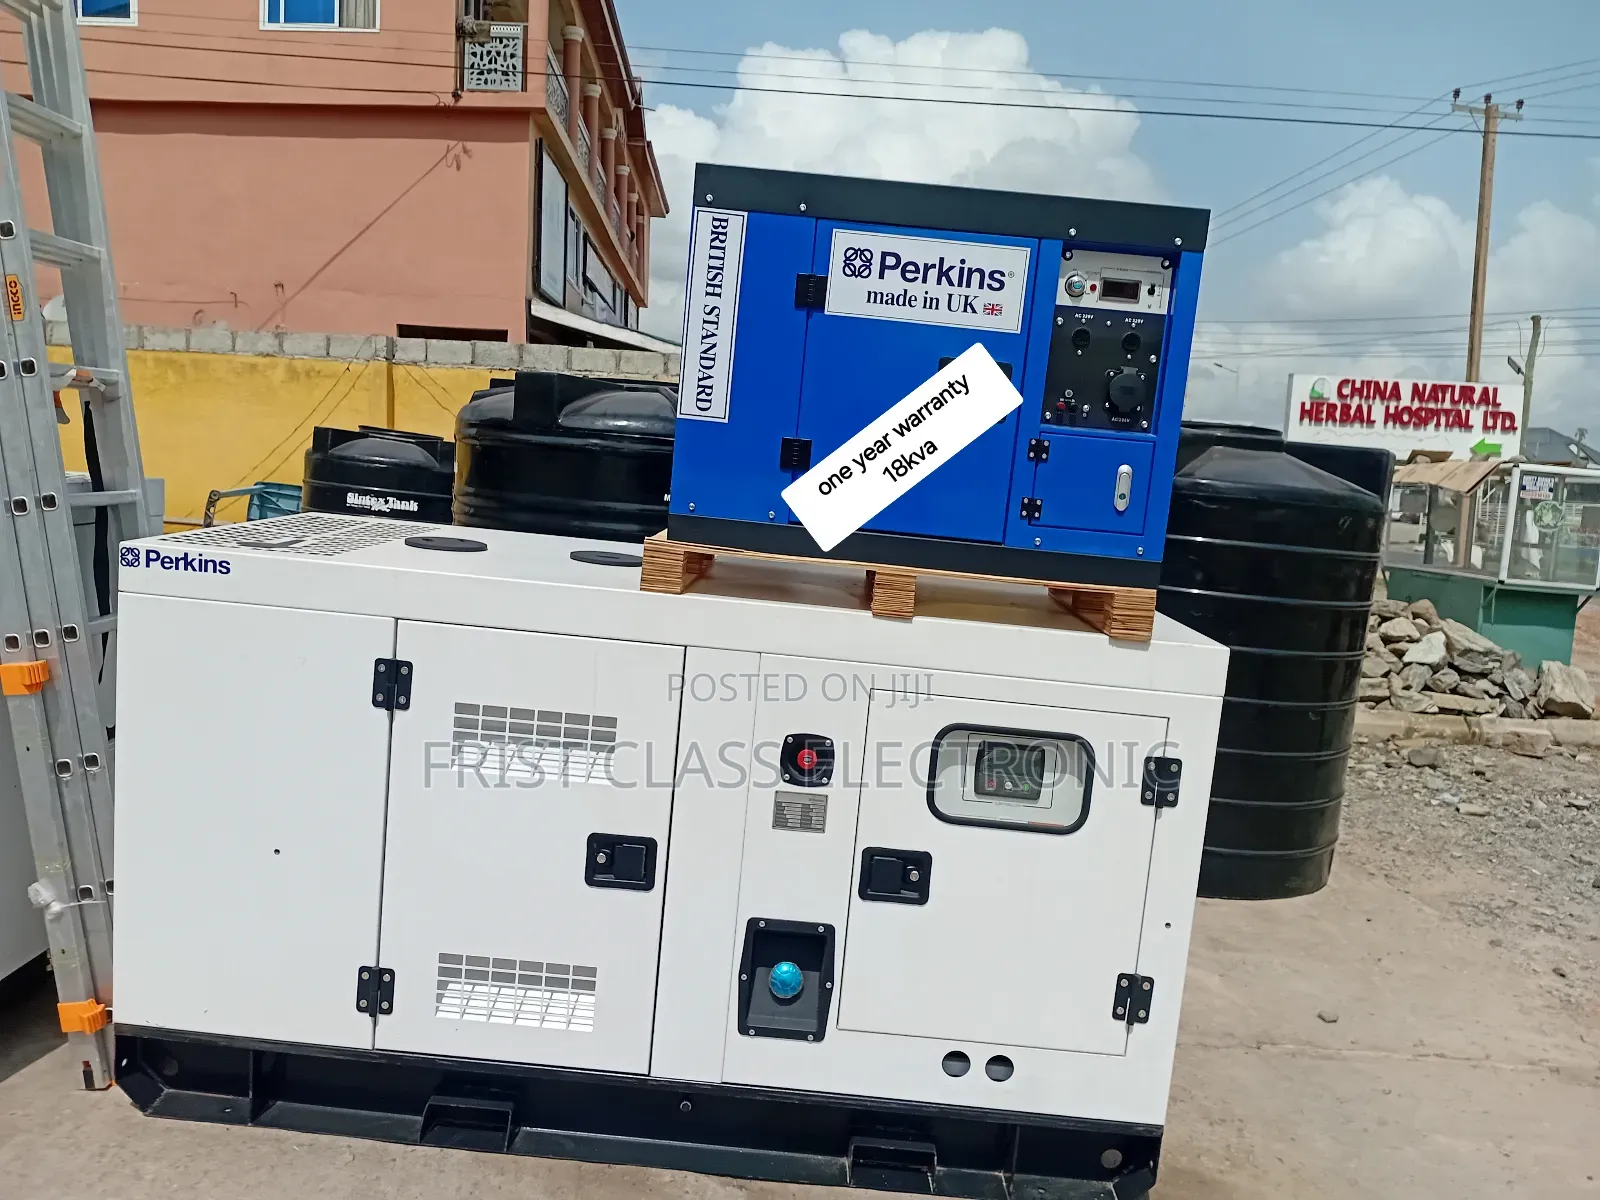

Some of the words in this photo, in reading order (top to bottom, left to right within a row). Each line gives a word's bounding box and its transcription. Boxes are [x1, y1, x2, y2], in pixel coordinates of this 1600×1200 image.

[704, 215, 730, 299] BRITISH
[878, 250, 1006, 292] Perkins
[866, 289, 918, 308] made
[922, 290, 940, 311] in
[946, 293, 980, 315] UK
[695, 303, 721, 412] STANDARD
[1336, 378, 1402, 401] CHINA
[1411, 382, 1502, 408] NATURAL
[1299, 401, 1376, 426] HERBAL
[1383, 405, 1474, 430] HOSPITAL
[1482, 410, 1518, 432] LTD.
[145, 549, 231, 575] Perkins
